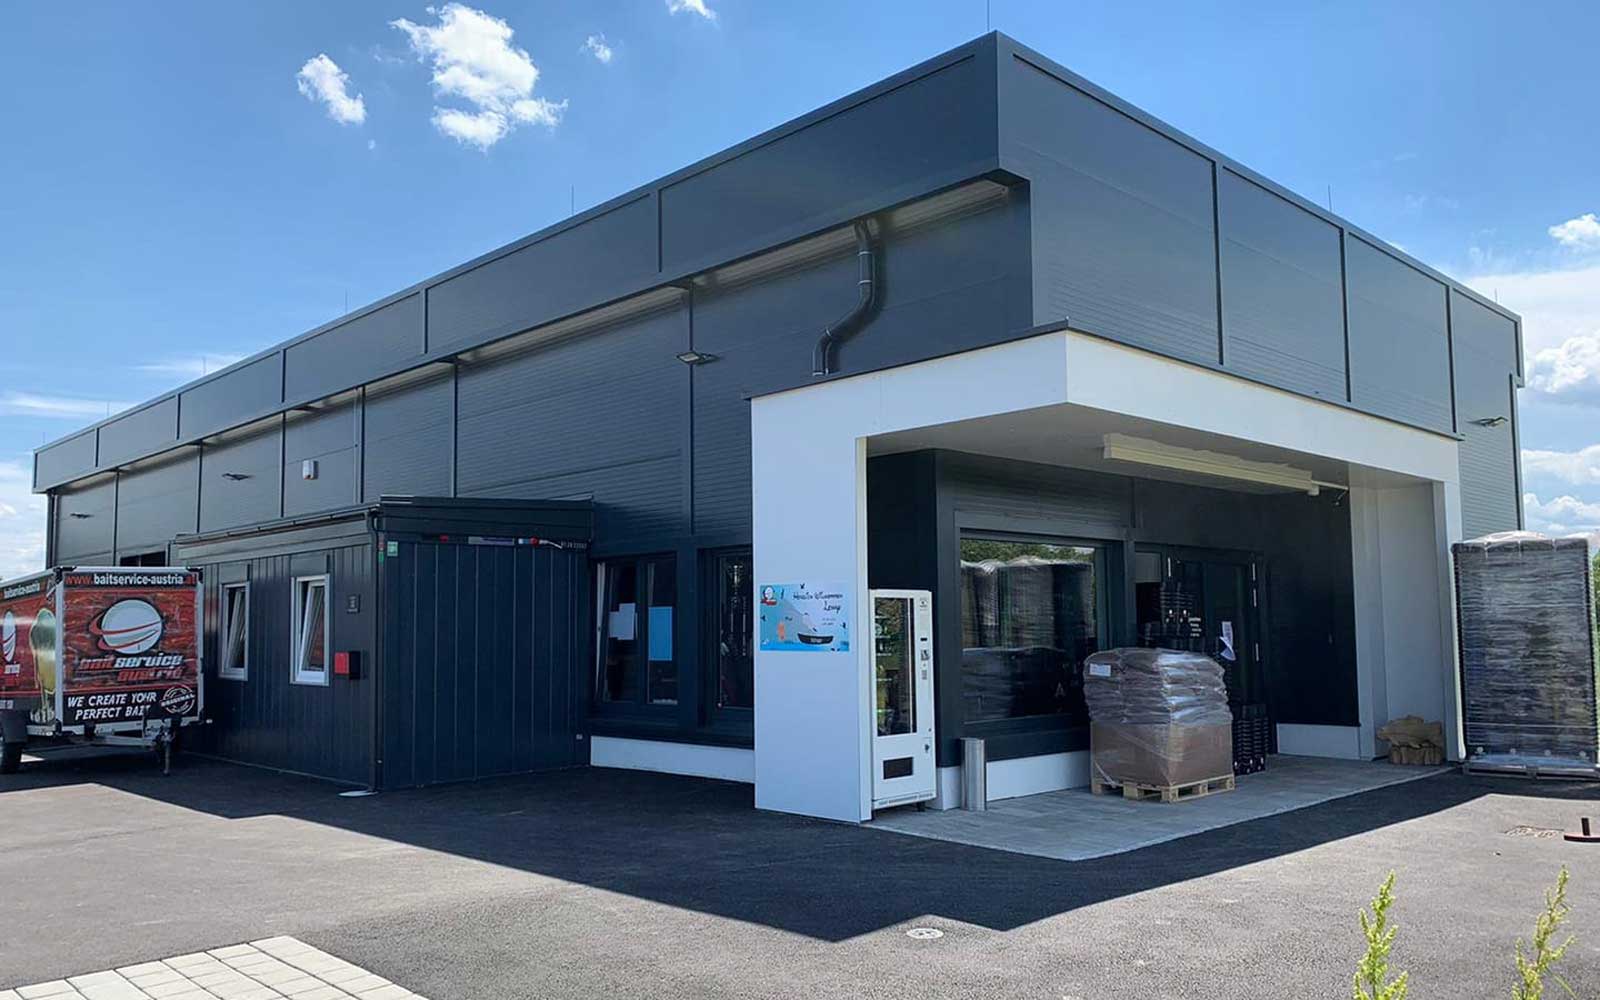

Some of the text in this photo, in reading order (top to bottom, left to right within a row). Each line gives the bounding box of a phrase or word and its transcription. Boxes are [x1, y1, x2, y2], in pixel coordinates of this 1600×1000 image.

[67, 691, 157, 707] WE CREATE YOUR
[75, 704, 151, 720] PERFECT BAIT
